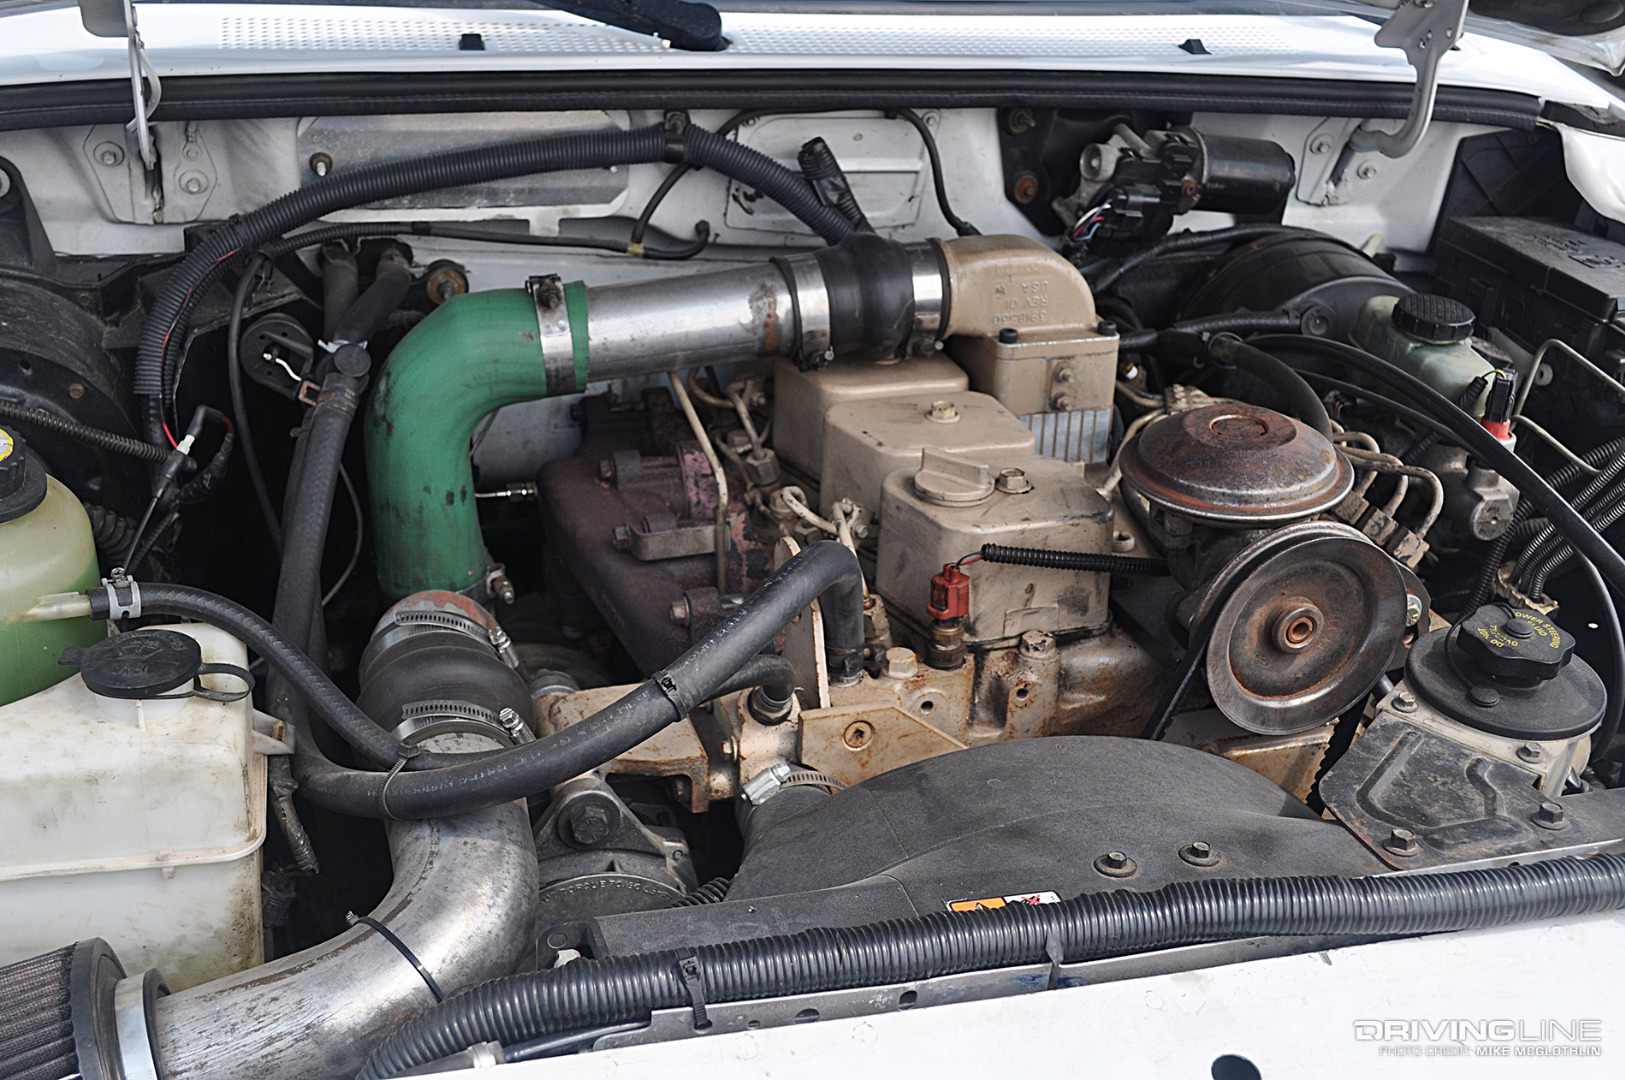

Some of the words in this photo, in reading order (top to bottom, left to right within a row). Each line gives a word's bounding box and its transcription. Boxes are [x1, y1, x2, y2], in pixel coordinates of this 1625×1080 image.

[1515, 611, 1544, 625] OWER
[1542, 623, 1561, 649] STEERING
[1489, 638, 1505, 648] DO
[560, 880, 606, 895] TORQUE
